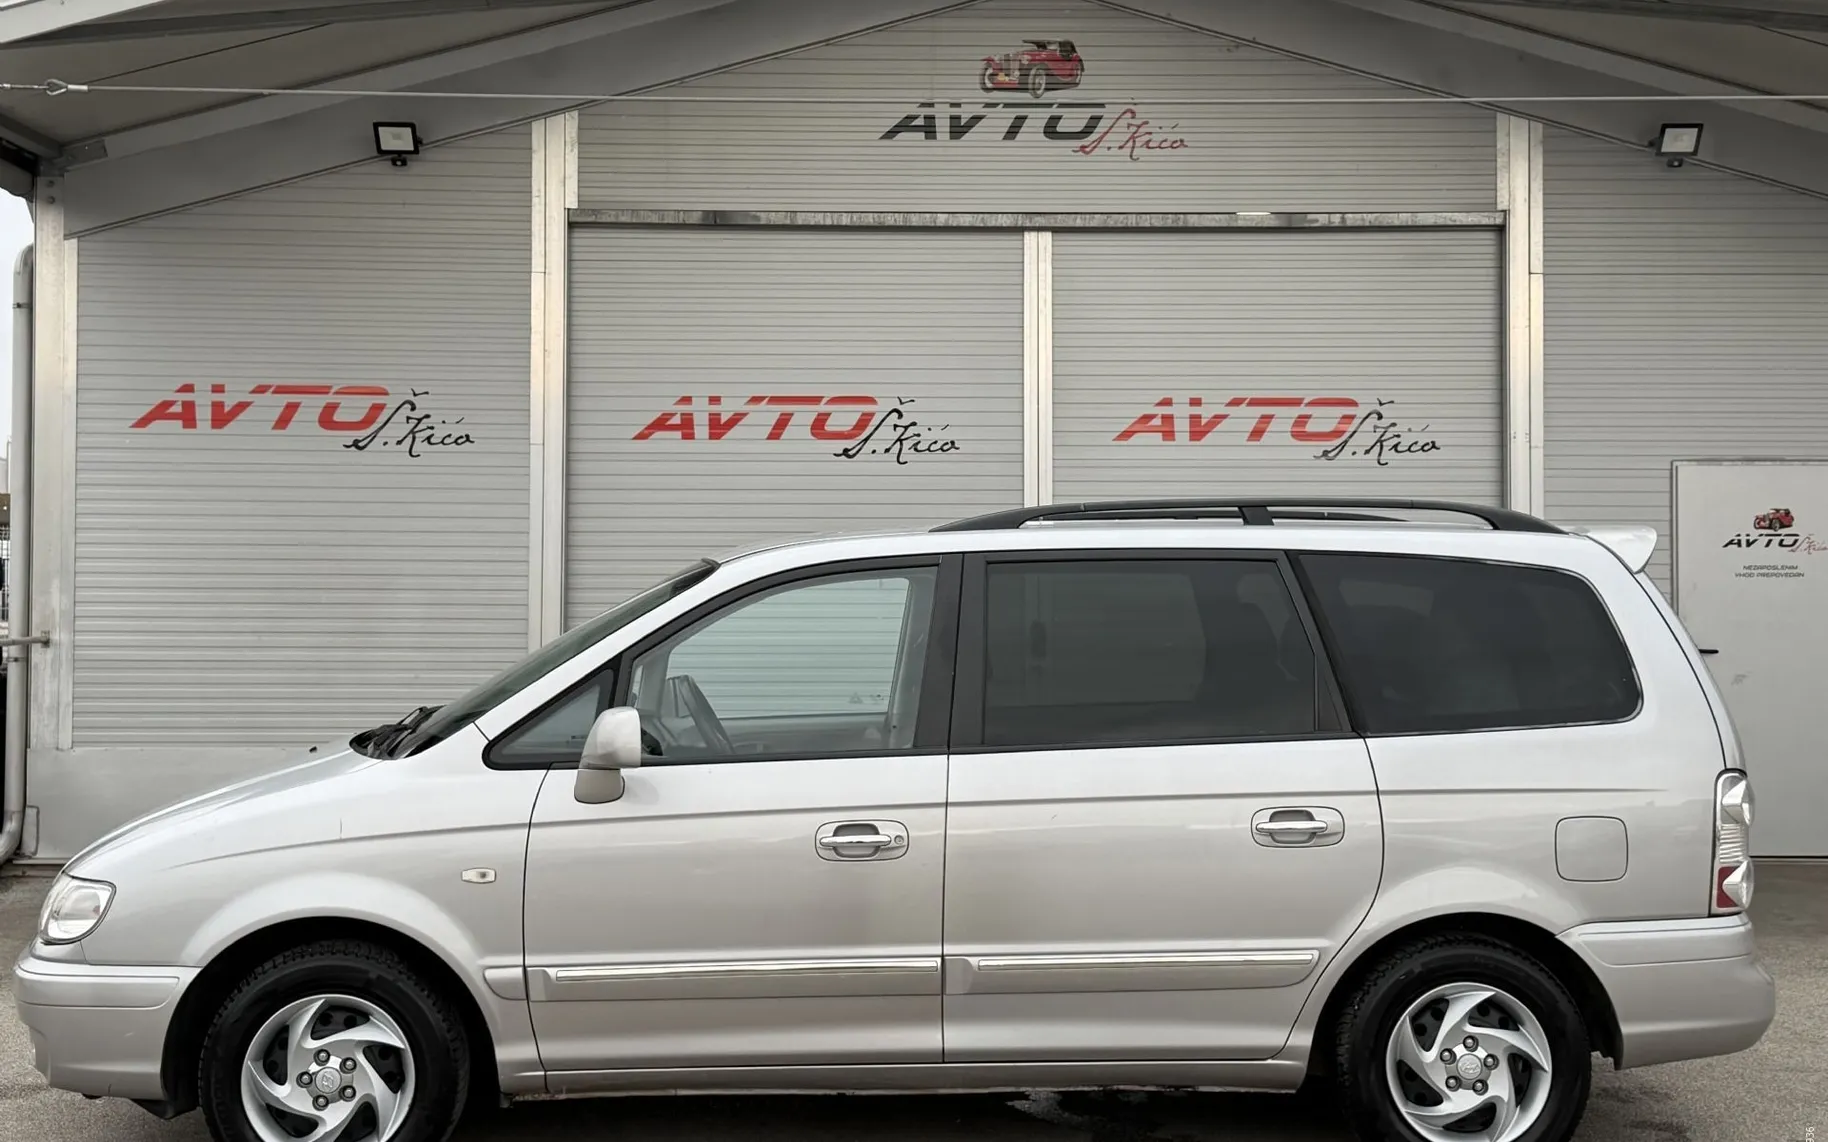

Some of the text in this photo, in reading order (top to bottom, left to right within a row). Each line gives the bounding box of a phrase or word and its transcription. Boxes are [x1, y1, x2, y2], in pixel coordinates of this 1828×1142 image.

[878, 102, 1106, 140] AVTO
[129, 383, 390, 431] AVTO
[631, 395, 878, 440] AVTO
[1112, 397, 1359, 442] AVTO
[1722, 533, 1800, 548] AVTO
